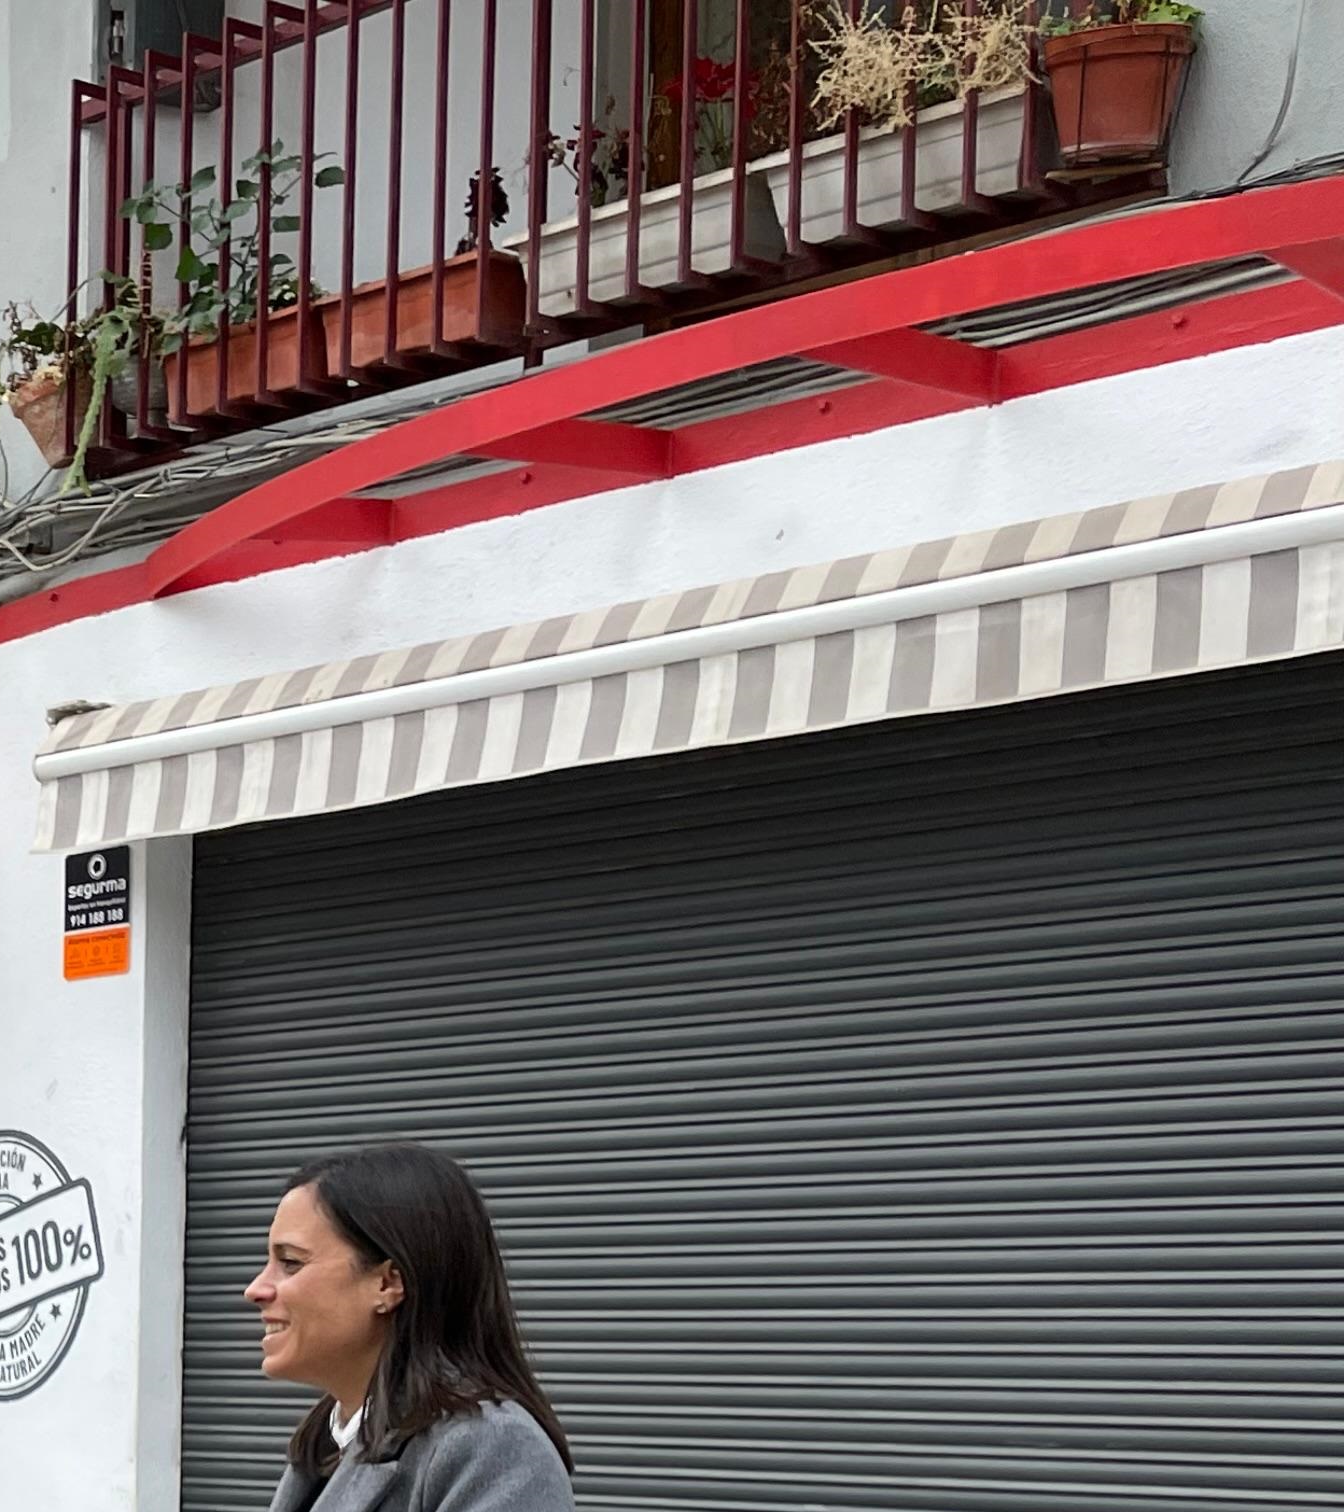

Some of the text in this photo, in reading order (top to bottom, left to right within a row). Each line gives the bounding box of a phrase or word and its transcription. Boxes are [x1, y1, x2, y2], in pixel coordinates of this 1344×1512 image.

[67, 878, 127, 900] segurma
[11, 1220, 93, 1286] 100%
[8, 1313, 46, 1360] MADRE
